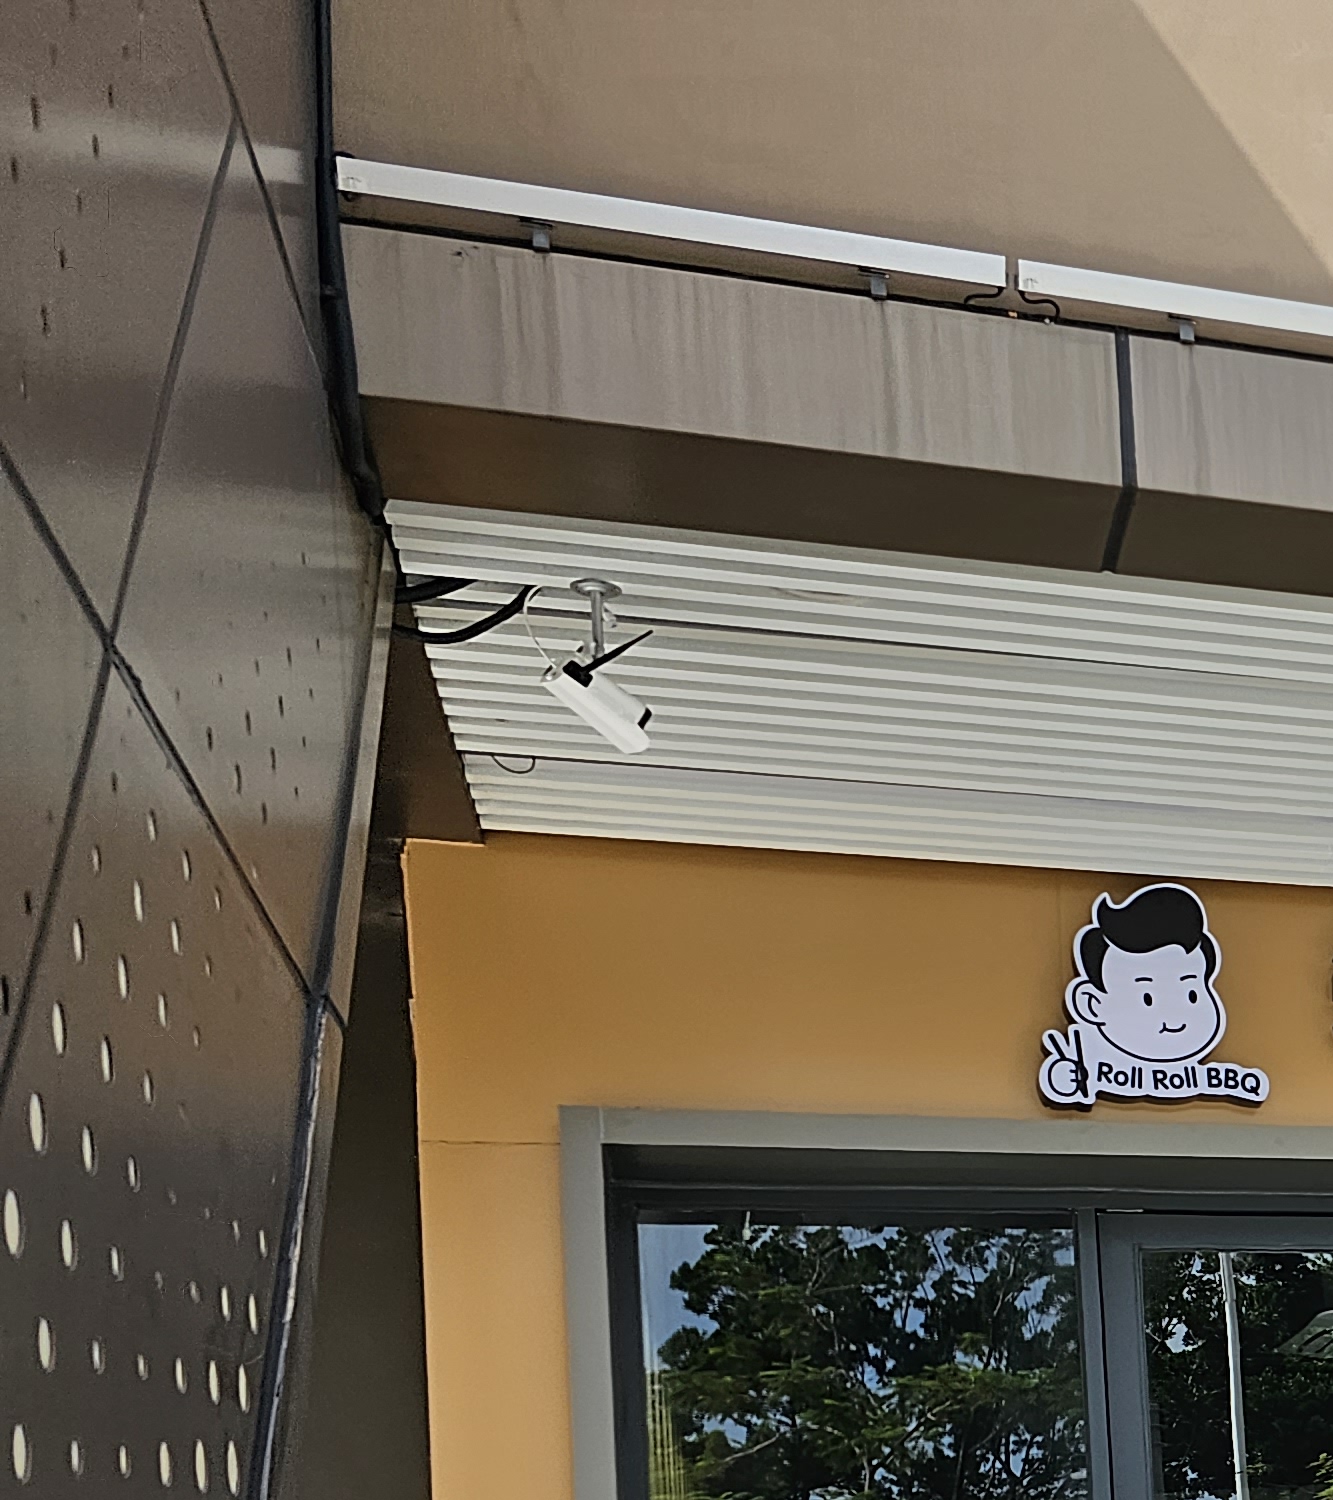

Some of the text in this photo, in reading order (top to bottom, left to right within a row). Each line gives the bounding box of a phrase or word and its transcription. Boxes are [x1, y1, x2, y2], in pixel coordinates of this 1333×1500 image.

[1097, 1062, 1261, 1096] Roll Roll BBQ
